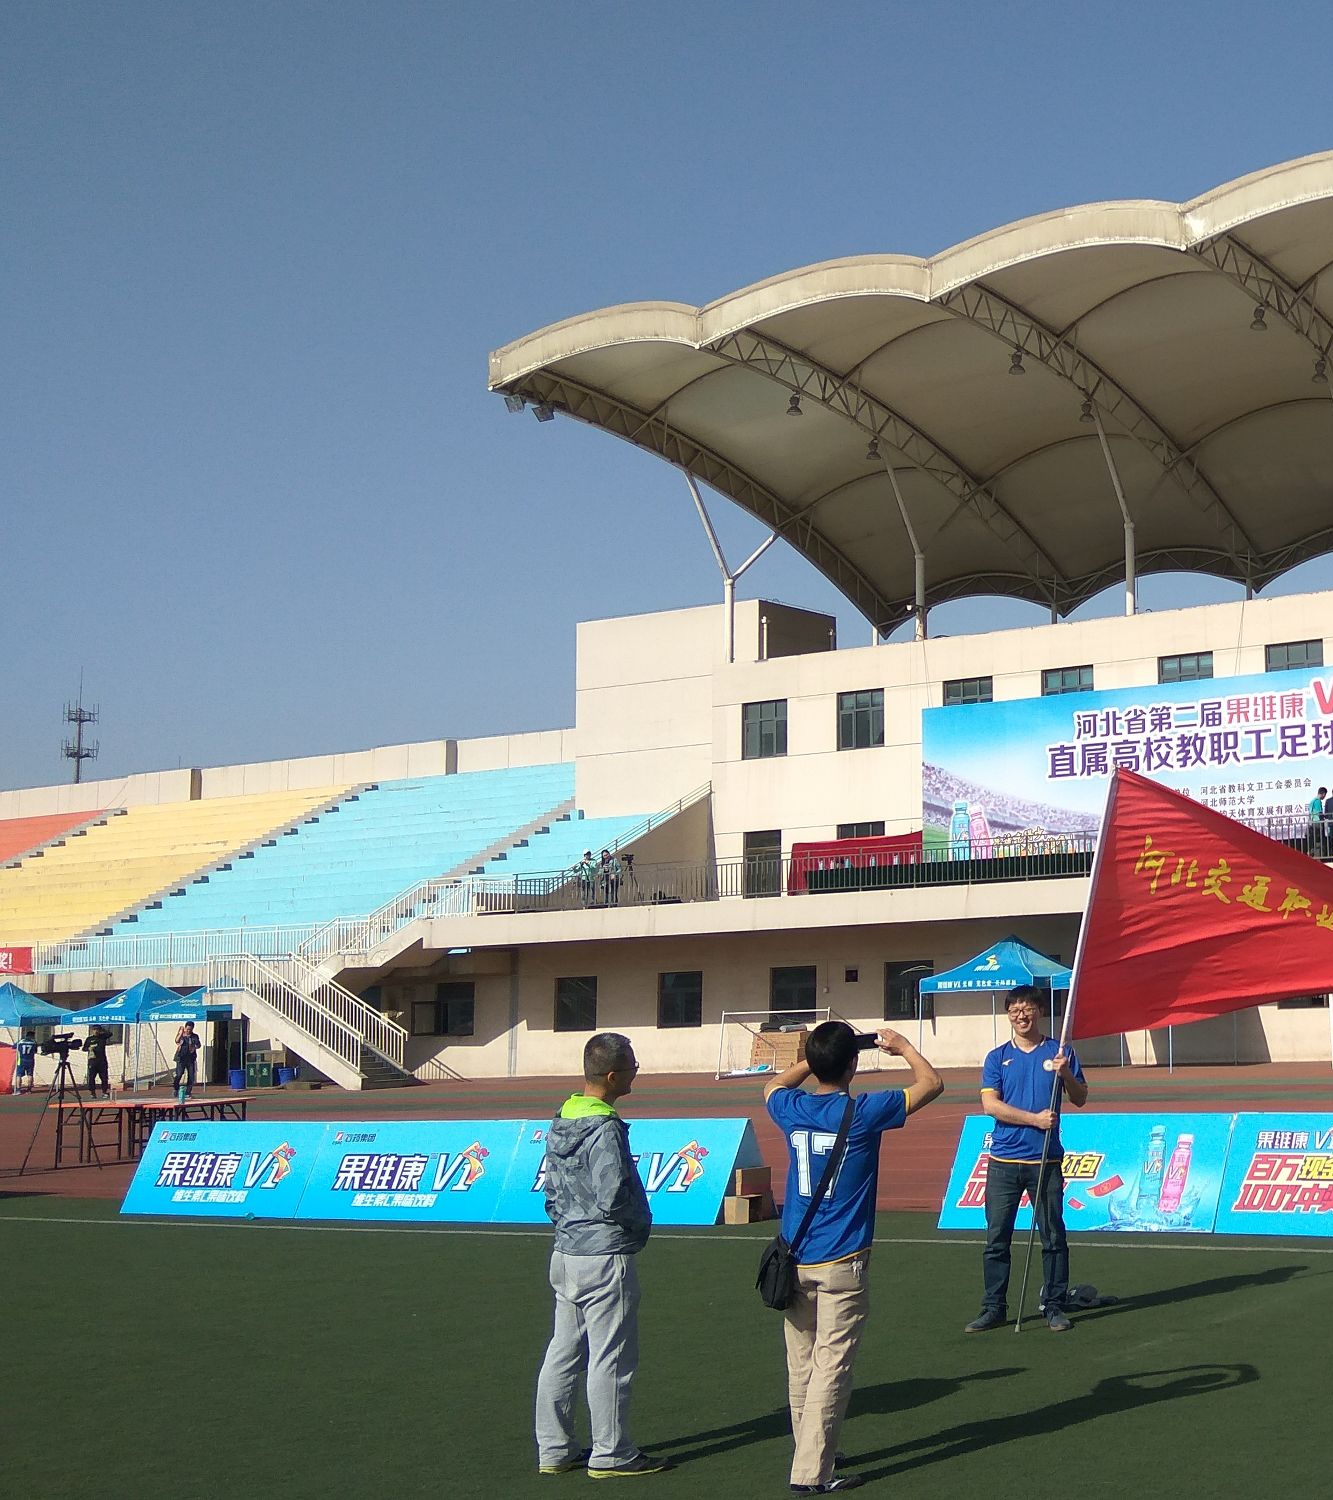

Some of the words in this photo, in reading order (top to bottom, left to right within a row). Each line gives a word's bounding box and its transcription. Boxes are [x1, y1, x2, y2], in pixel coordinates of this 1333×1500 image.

[1200, 777, 1312, 795] 河北省教科文卫工会委员会
[1257, 1131, 1309, 1150] 果维康
[155, 1152, 242, 1187] 果维康
[244, 1152, 281, 1188] V1
[332, 1154, 429, 1191] 果维康
[432, 1153, 473, 1192] V1
[646, 1153, 692, 1192] V1
